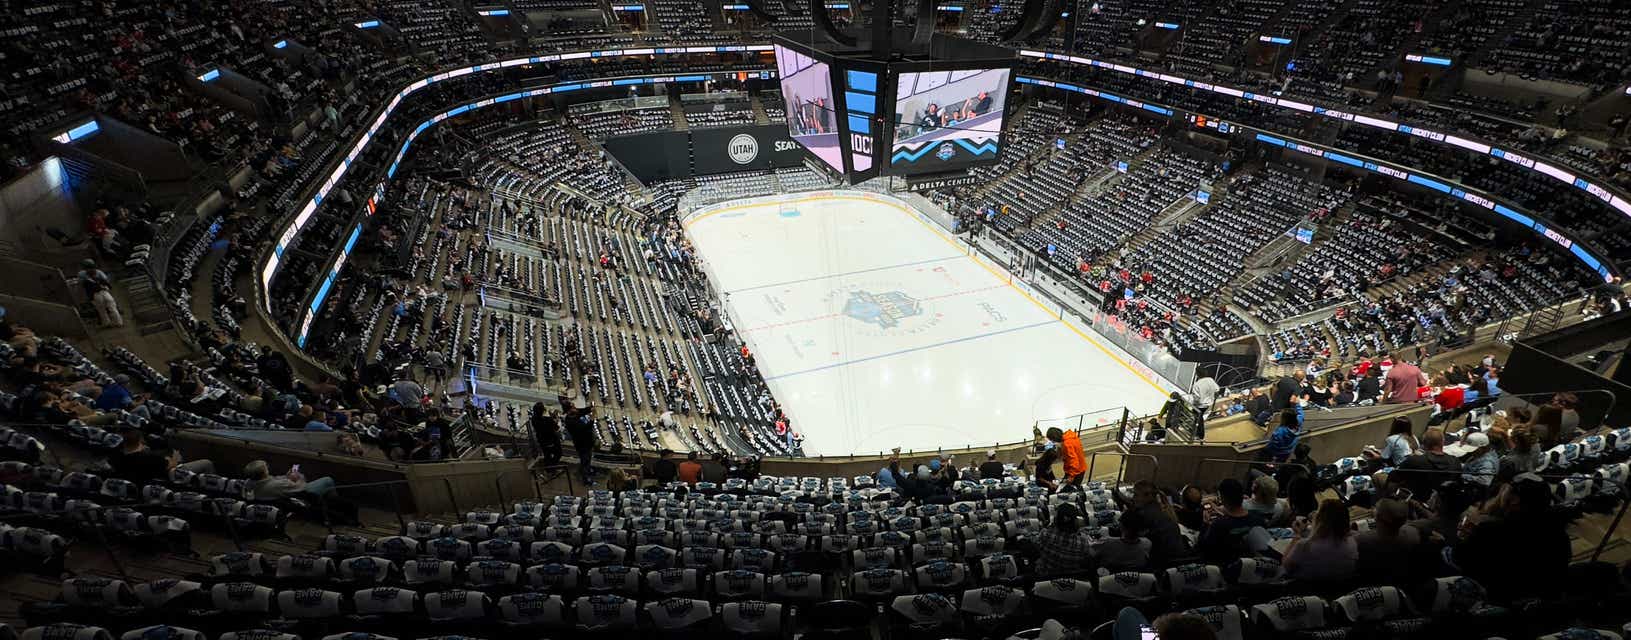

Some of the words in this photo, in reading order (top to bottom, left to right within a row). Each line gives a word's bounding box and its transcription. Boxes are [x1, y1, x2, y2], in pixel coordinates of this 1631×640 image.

[733, 144, 753, 155] UTAH
[919, 181, 945, 190] DELTA
[947, 178, 975, 186] CENTER
